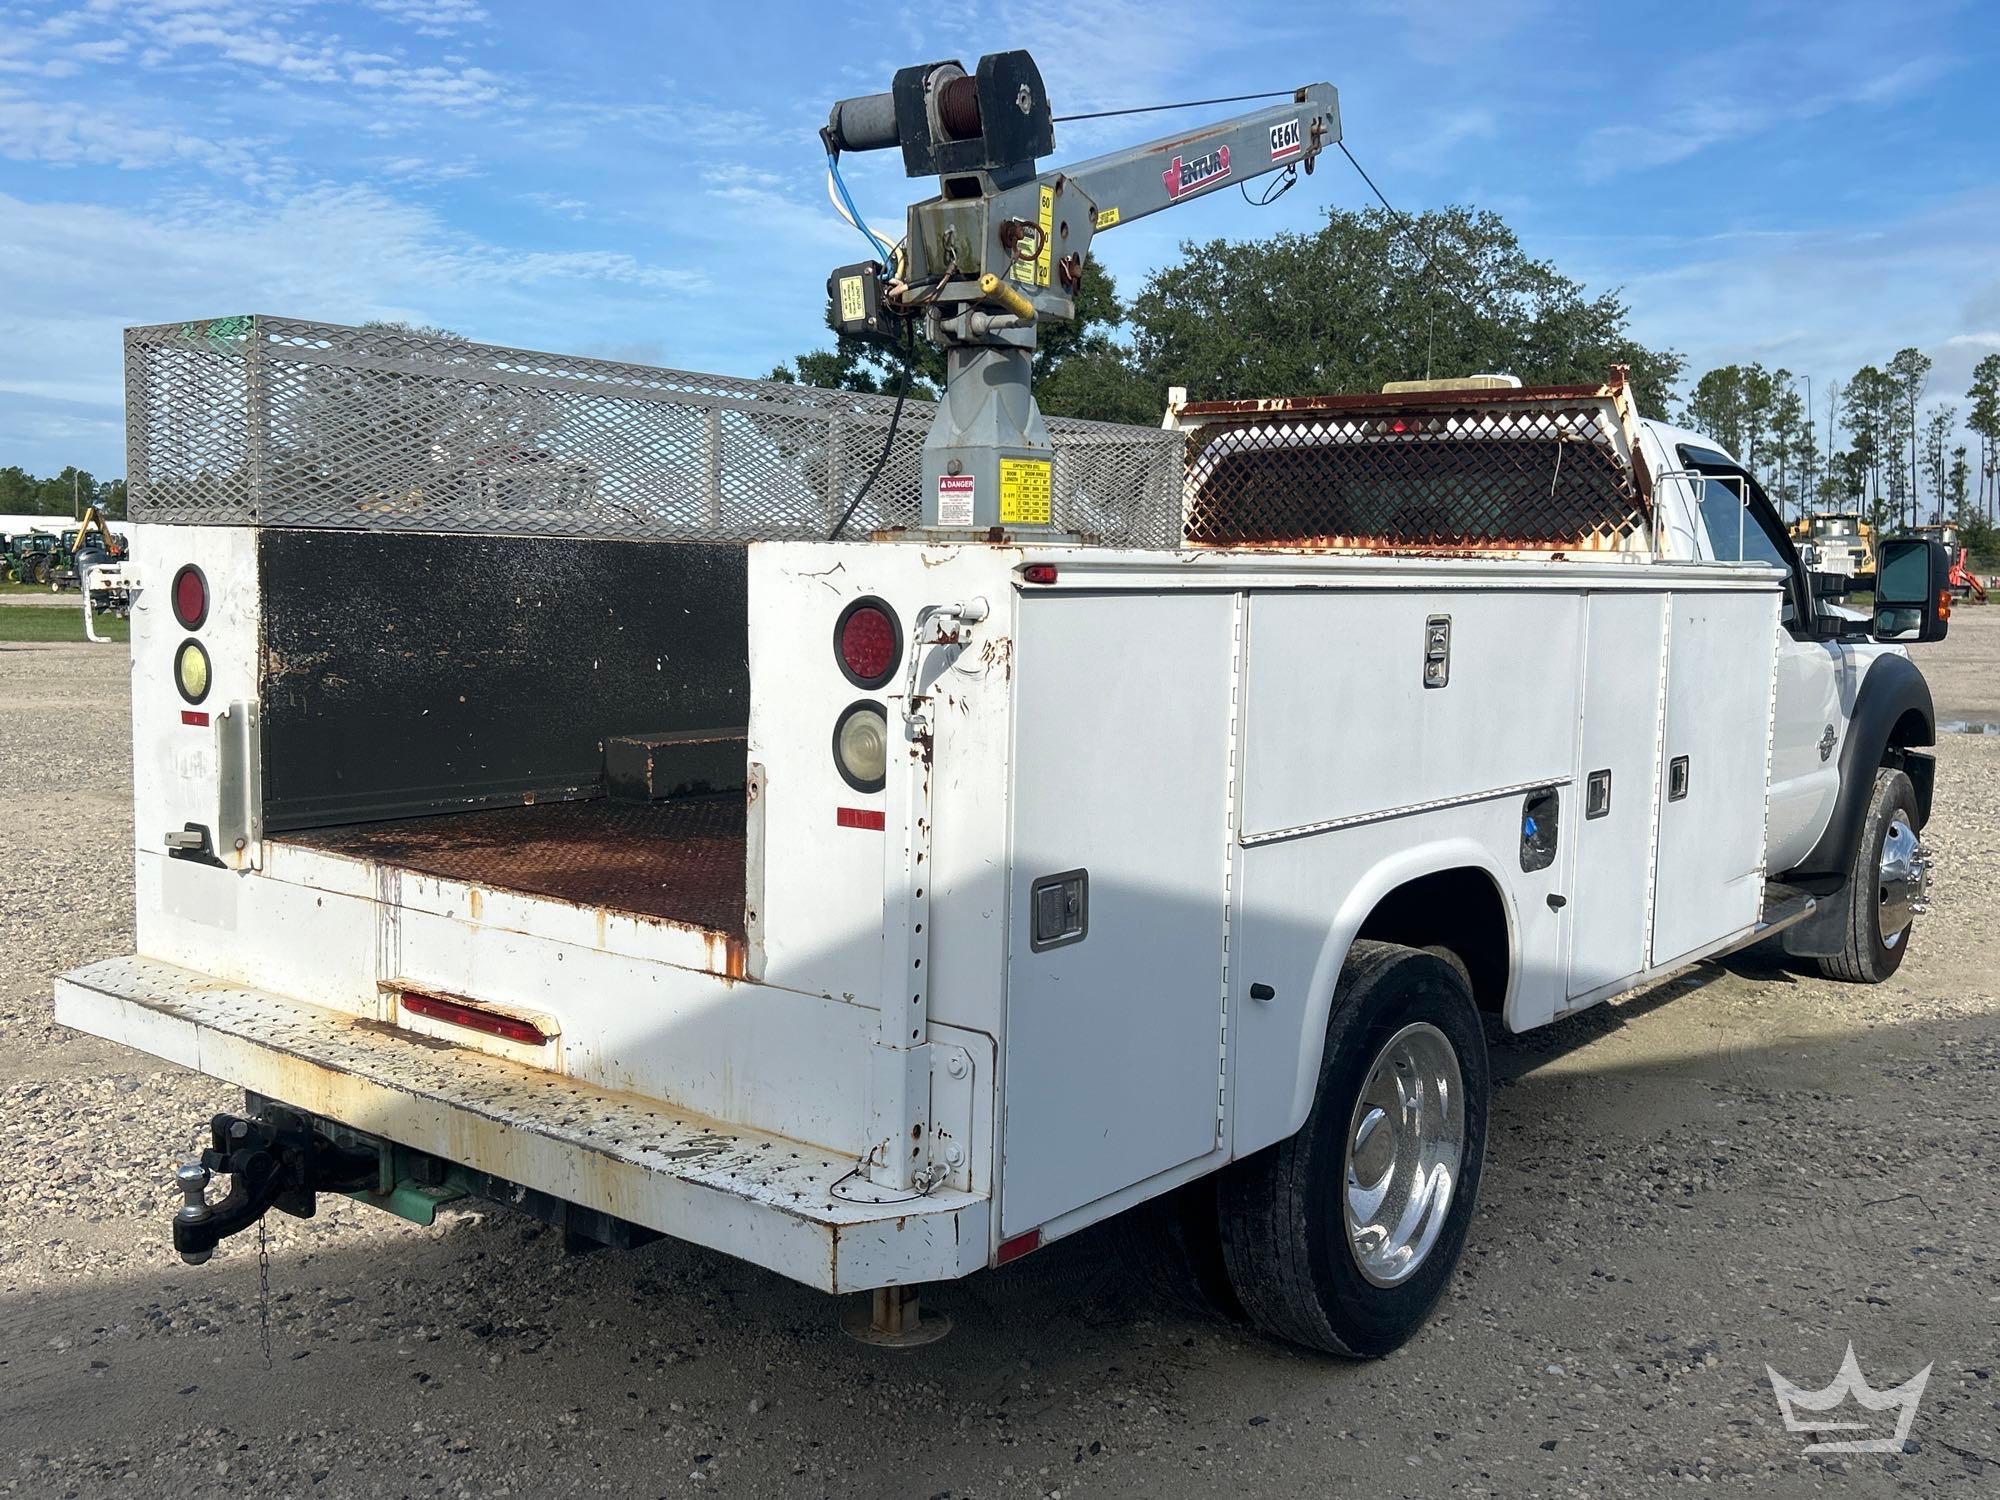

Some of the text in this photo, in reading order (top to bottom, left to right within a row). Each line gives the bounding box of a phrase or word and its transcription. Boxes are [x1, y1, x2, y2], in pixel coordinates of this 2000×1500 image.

[1271, 122, 1300, 149] CE6K
[1162, 145, 1230, 199] VENTURO
[947, 480, 974, 488] DANGER
